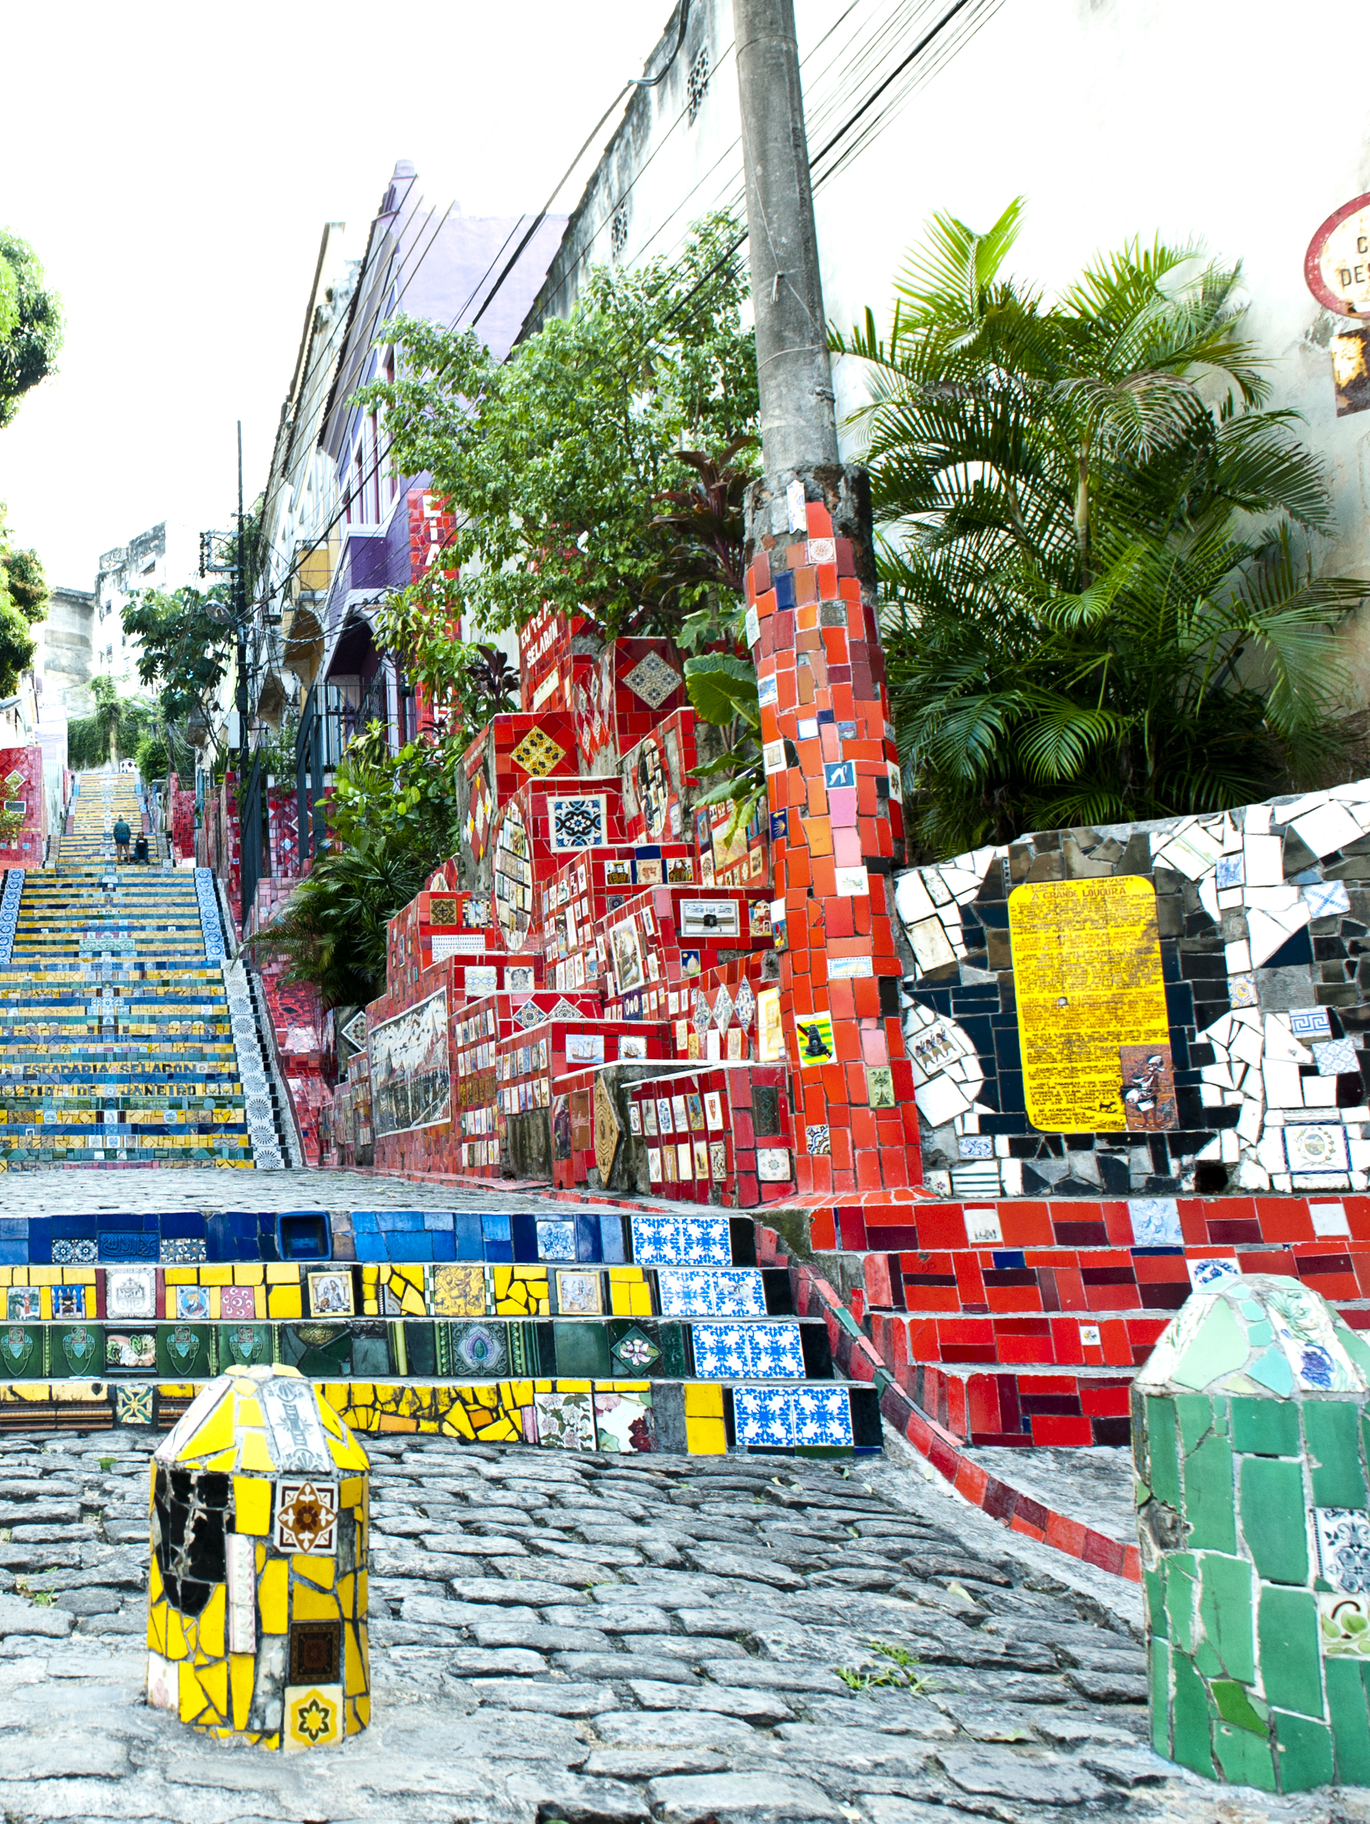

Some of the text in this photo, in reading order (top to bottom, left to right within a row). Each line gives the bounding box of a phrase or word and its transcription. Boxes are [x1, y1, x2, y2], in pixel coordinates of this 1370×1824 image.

[1341, 263, 1370, 286] DE
[1042, 890, 1079, 899] GRANDE
[1082, 886, 1126, 897] LOUCURA
[24, 1063, 111, 1073] ESCADARIA
[24, 1085, 196, 1096] RIO DE JANEIRO
